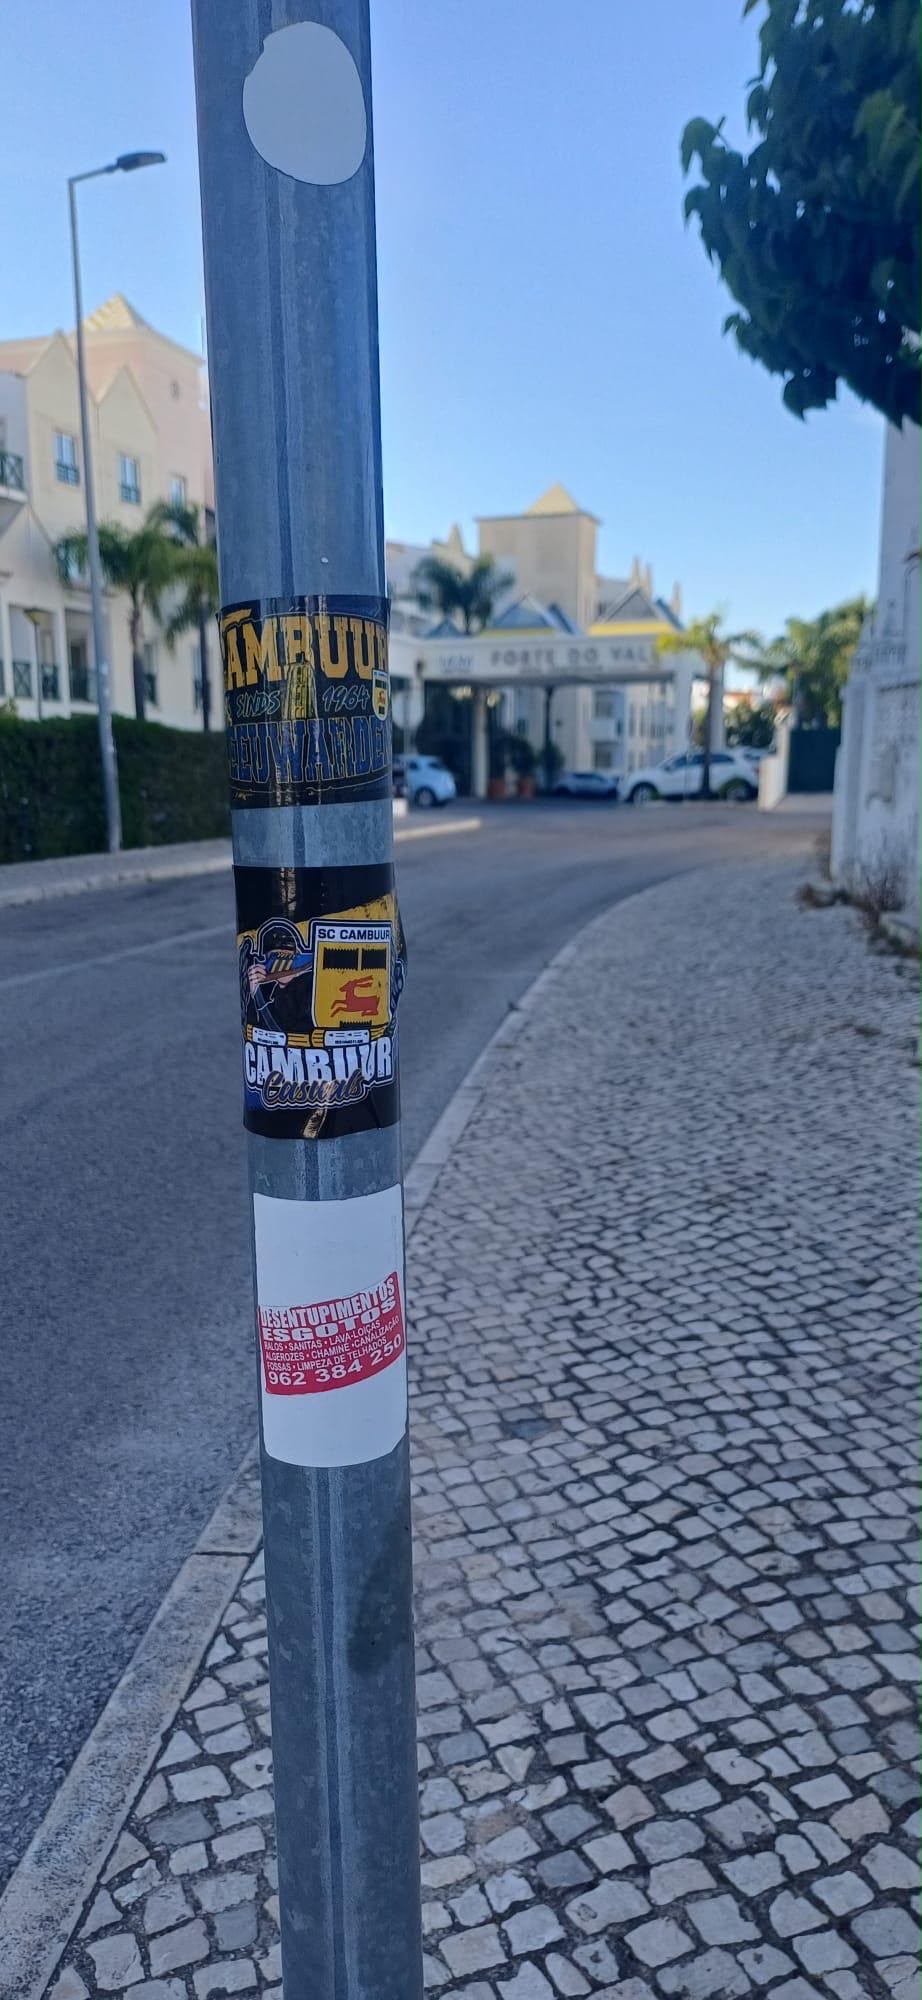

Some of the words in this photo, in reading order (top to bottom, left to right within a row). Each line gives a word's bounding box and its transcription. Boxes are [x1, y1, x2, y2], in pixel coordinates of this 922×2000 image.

[236, 690, 281, 717] SINDS
[322, 684, 371, 712] 1964
[317, 928, 336, 940] SC
[339, 928, 390, 941] CAMBUUR
[245, 1036, 393, 1085] CAMBUUR
[263, 1068, 365, 1105] Casuals
[259, 1277, 395, 1328] DESENTUPIMENTOS
[262, 1296, 396, 1342] ESGOTOS
[265, 1351, 305, 1361] ALGEROZES
[267, 1362, 292, 1371] FOSSAS
[296, 1358, 333, 1371] LIMPEZA
[334, 1354, 345, 1365] DE
[347, 1337, 387, 1360] TELHADOS
[268, 1371, 307, 1386] 962
[315, 1360, 363, 1382] 384
[370, 1334, 402, 1366] 250
[288, 1339, 323, 1351] SANITAS
